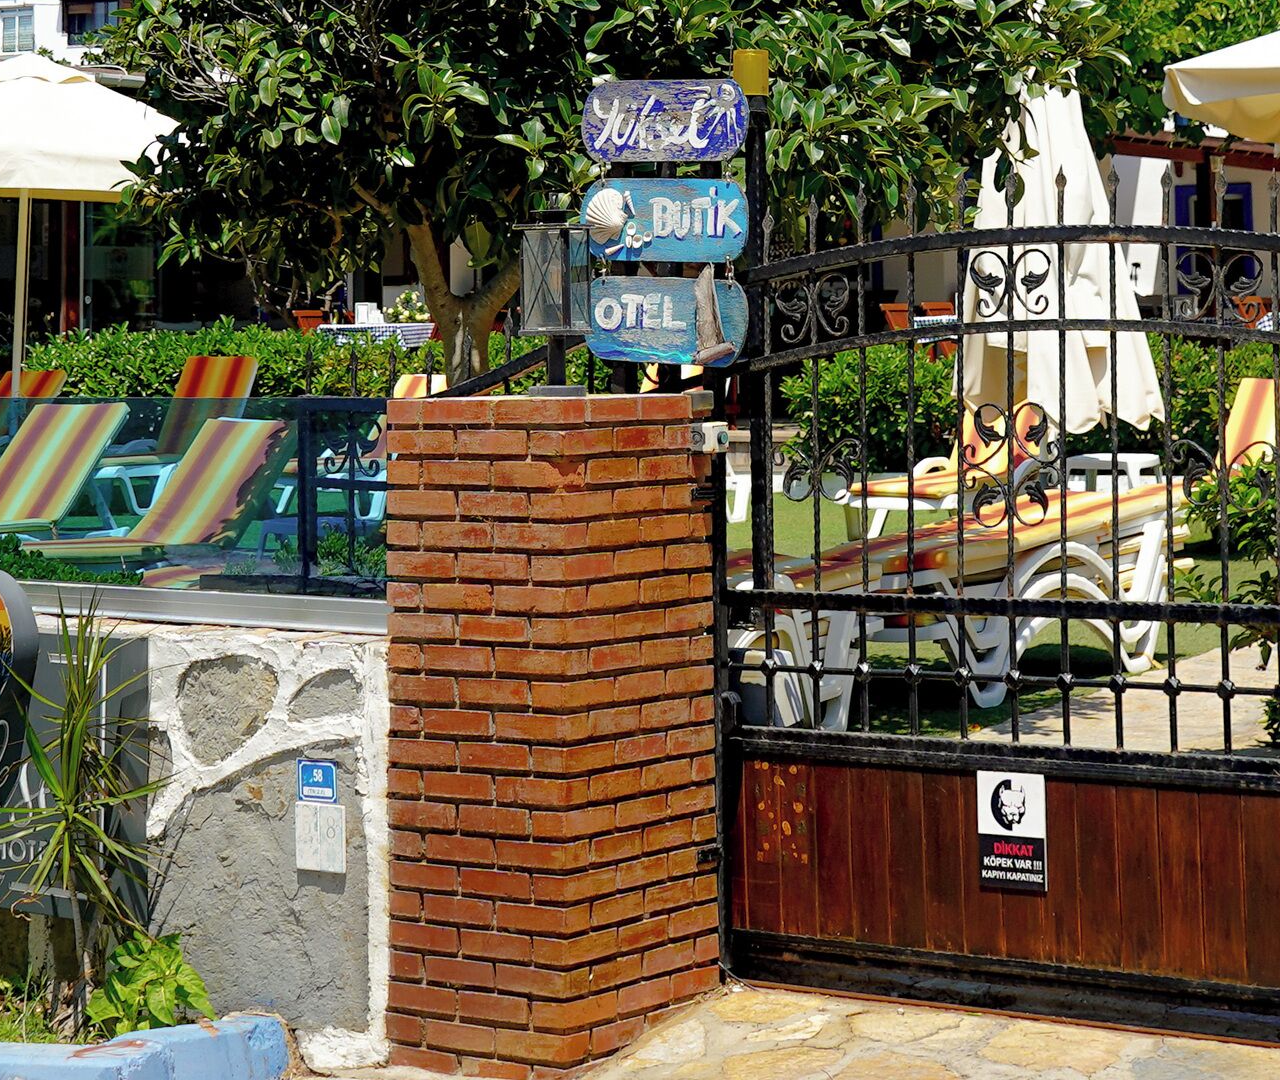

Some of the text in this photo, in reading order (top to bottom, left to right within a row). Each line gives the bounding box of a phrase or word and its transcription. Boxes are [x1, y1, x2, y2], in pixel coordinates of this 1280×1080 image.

[594, 293, 687, 331] OTEL
[313, 769, 323, 782] 58
[993, 840, 1034, 857] DİKKAT
[983, 855, 1014, 868] KÖPEK
[1014, 859, 1032, 870] VAR
[981, 869, 1044, 883] KAPIYI KAPATINIZ
